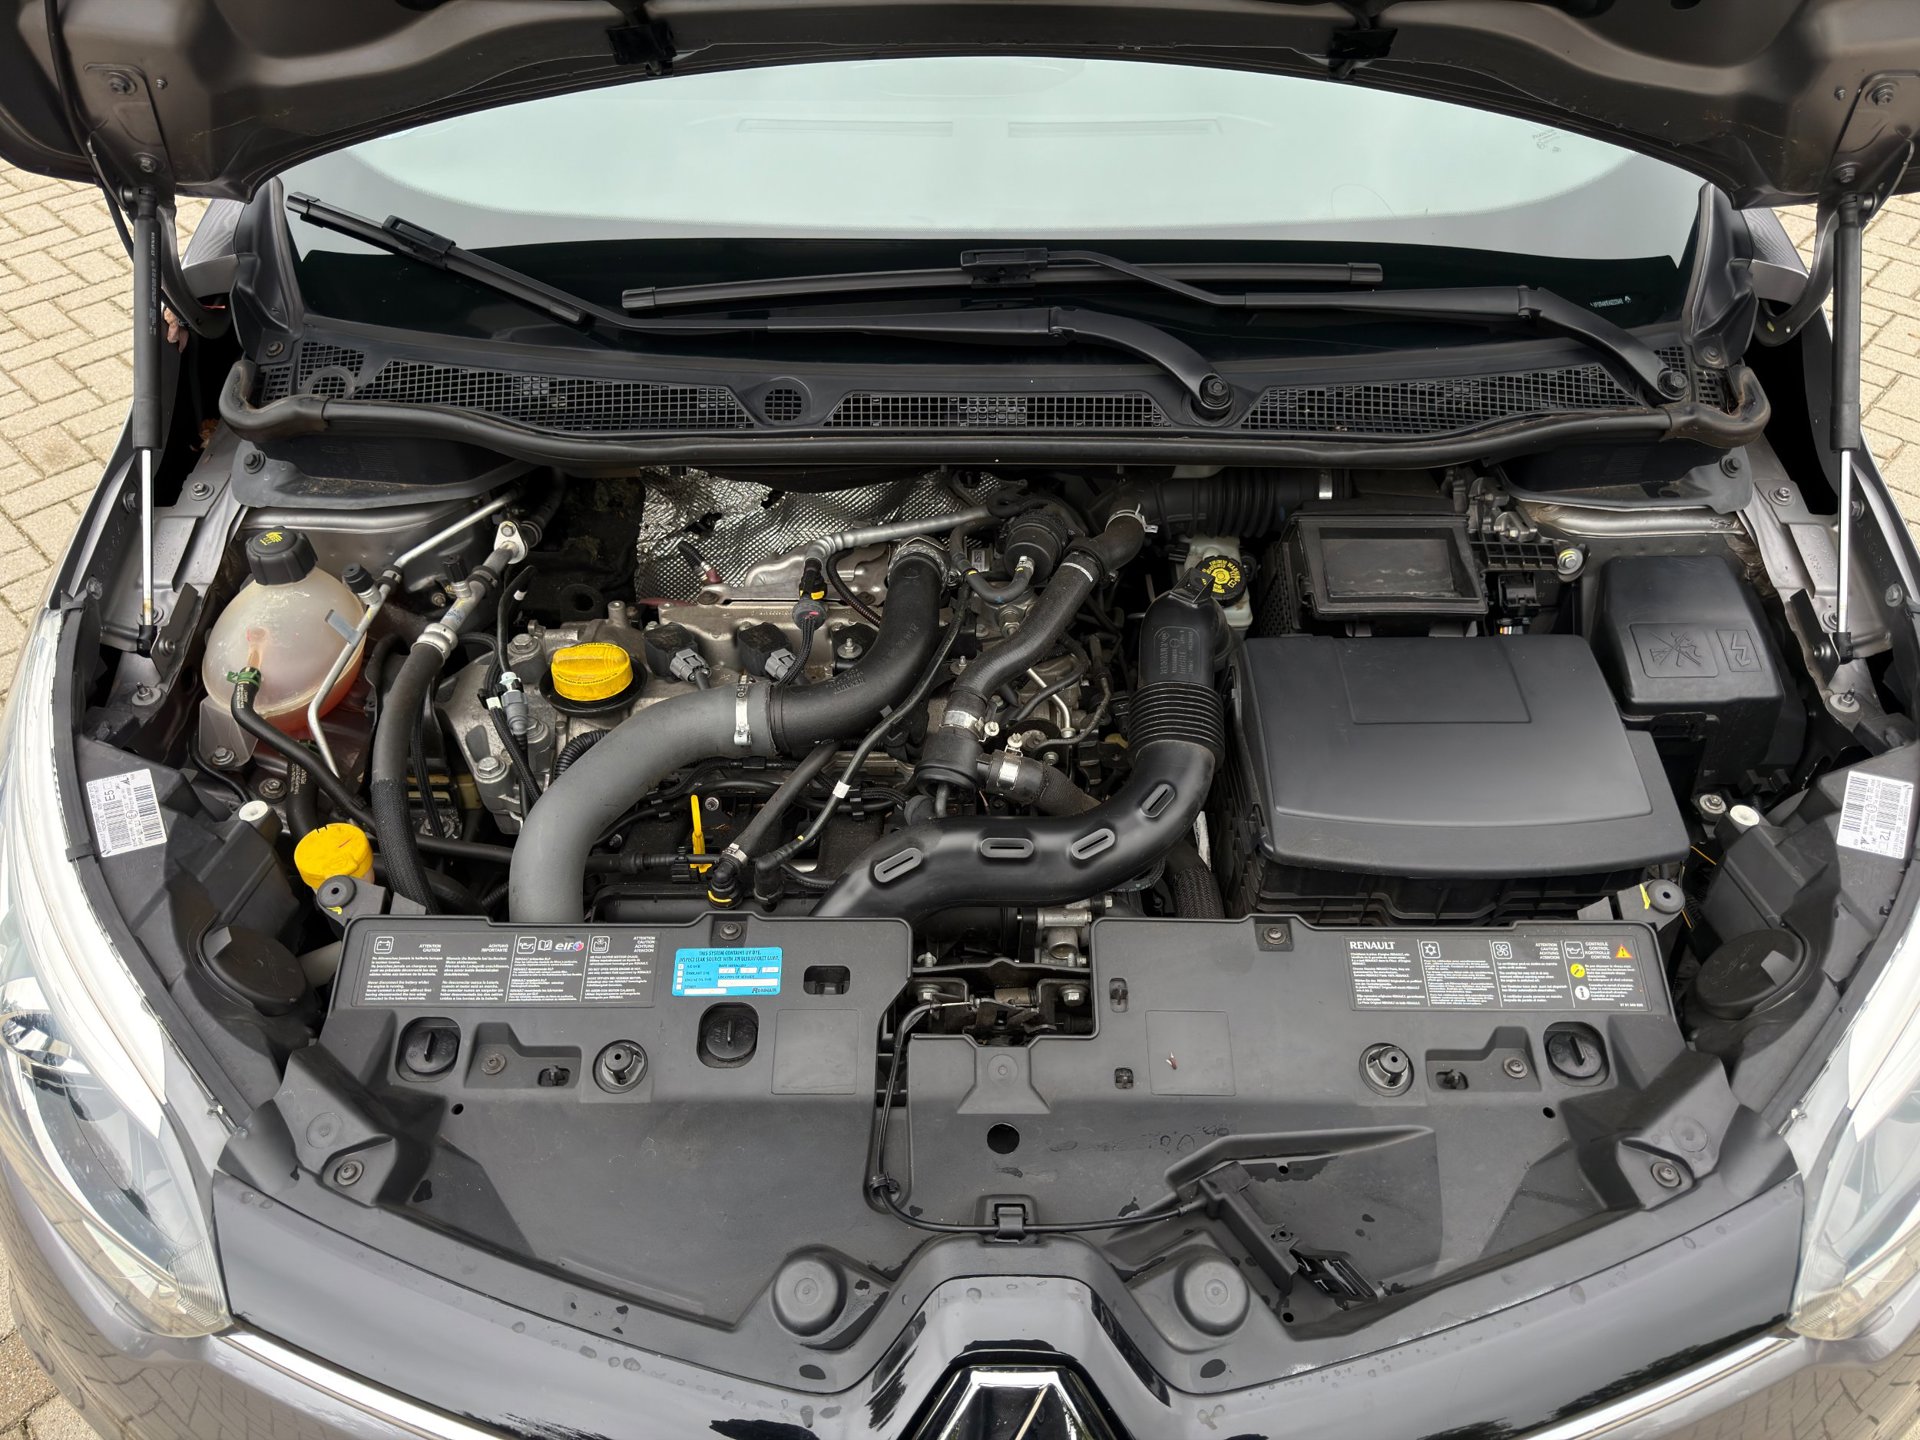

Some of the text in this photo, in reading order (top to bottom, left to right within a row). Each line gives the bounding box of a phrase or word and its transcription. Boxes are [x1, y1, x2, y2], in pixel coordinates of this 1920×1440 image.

[104, 790, 115, 801] E5
[1880, 830, 1891, 840] T2
[1350, 941, 1395, 949] RENAULT
